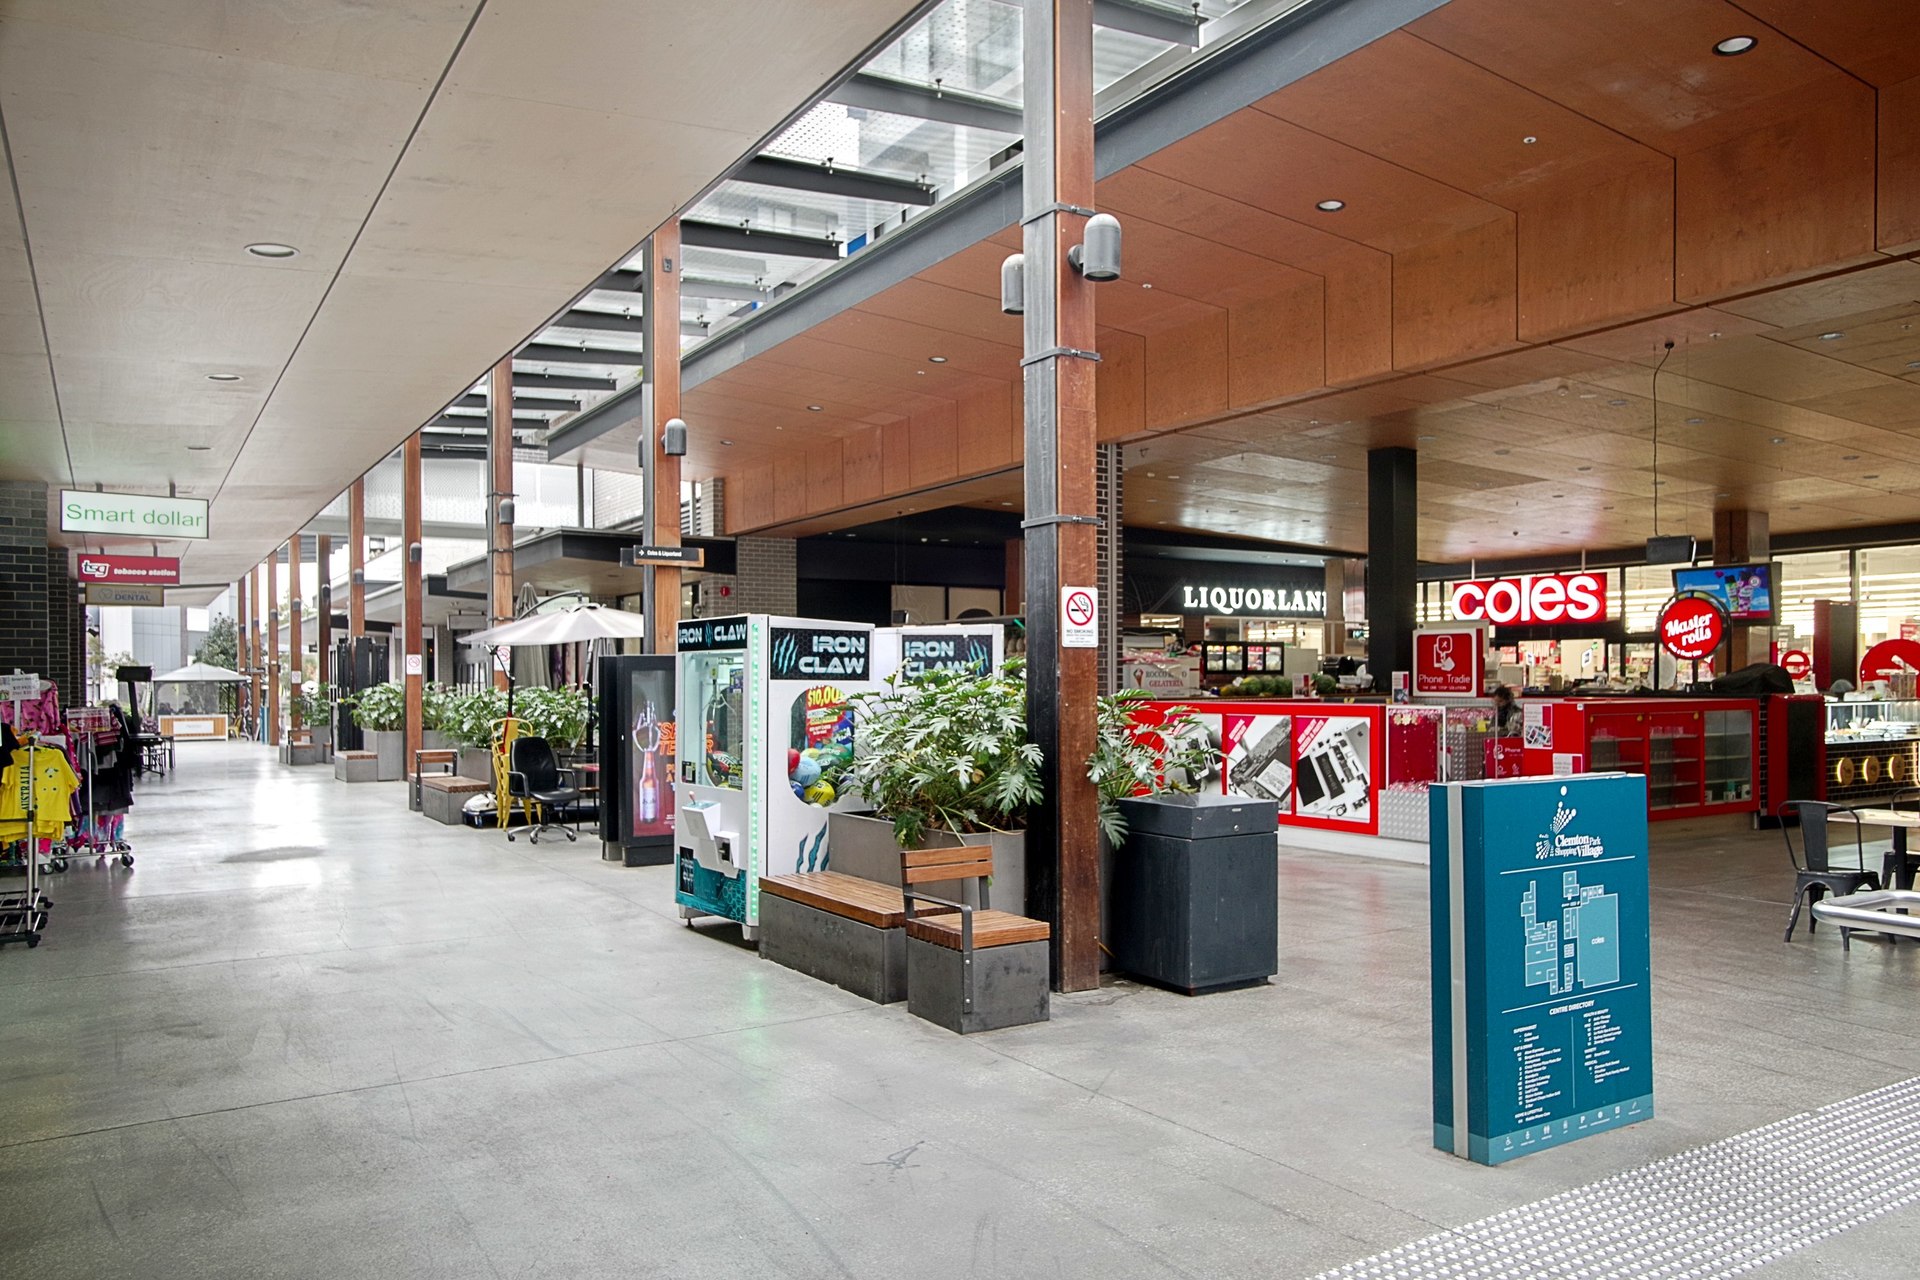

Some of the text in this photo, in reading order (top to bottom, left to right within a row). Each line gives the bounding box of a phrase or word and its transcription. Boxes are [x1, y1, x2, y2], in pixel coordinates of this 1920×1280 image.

[66, 504, 204, 527] Smart dollar
[82, 560, 111, 577] tsg
[113, 568, 177, 577] tobacco station
[1183, 586, 1326, 614] LIQUORLAN
[1451, 576, 1599, 622] coles
[678, 624, 747, 643] IRON CLAW
[1664, 613, 1713, 637] Master
[812, 636, 866, 654] IRON
[1681, 628, 1712, 646] rolls
[904, 641, 955, 657] IRON
[798, 656, 865, 674] CLAW
[1418, 674, 1471, 684] Phone Tradie
[1555, 834, 1602, 847] Clemton Park
[1555, 845, 1604, 858] Shopping Village
[1549, 1000, 1595, 1015] CENTRE DIRECTORY
